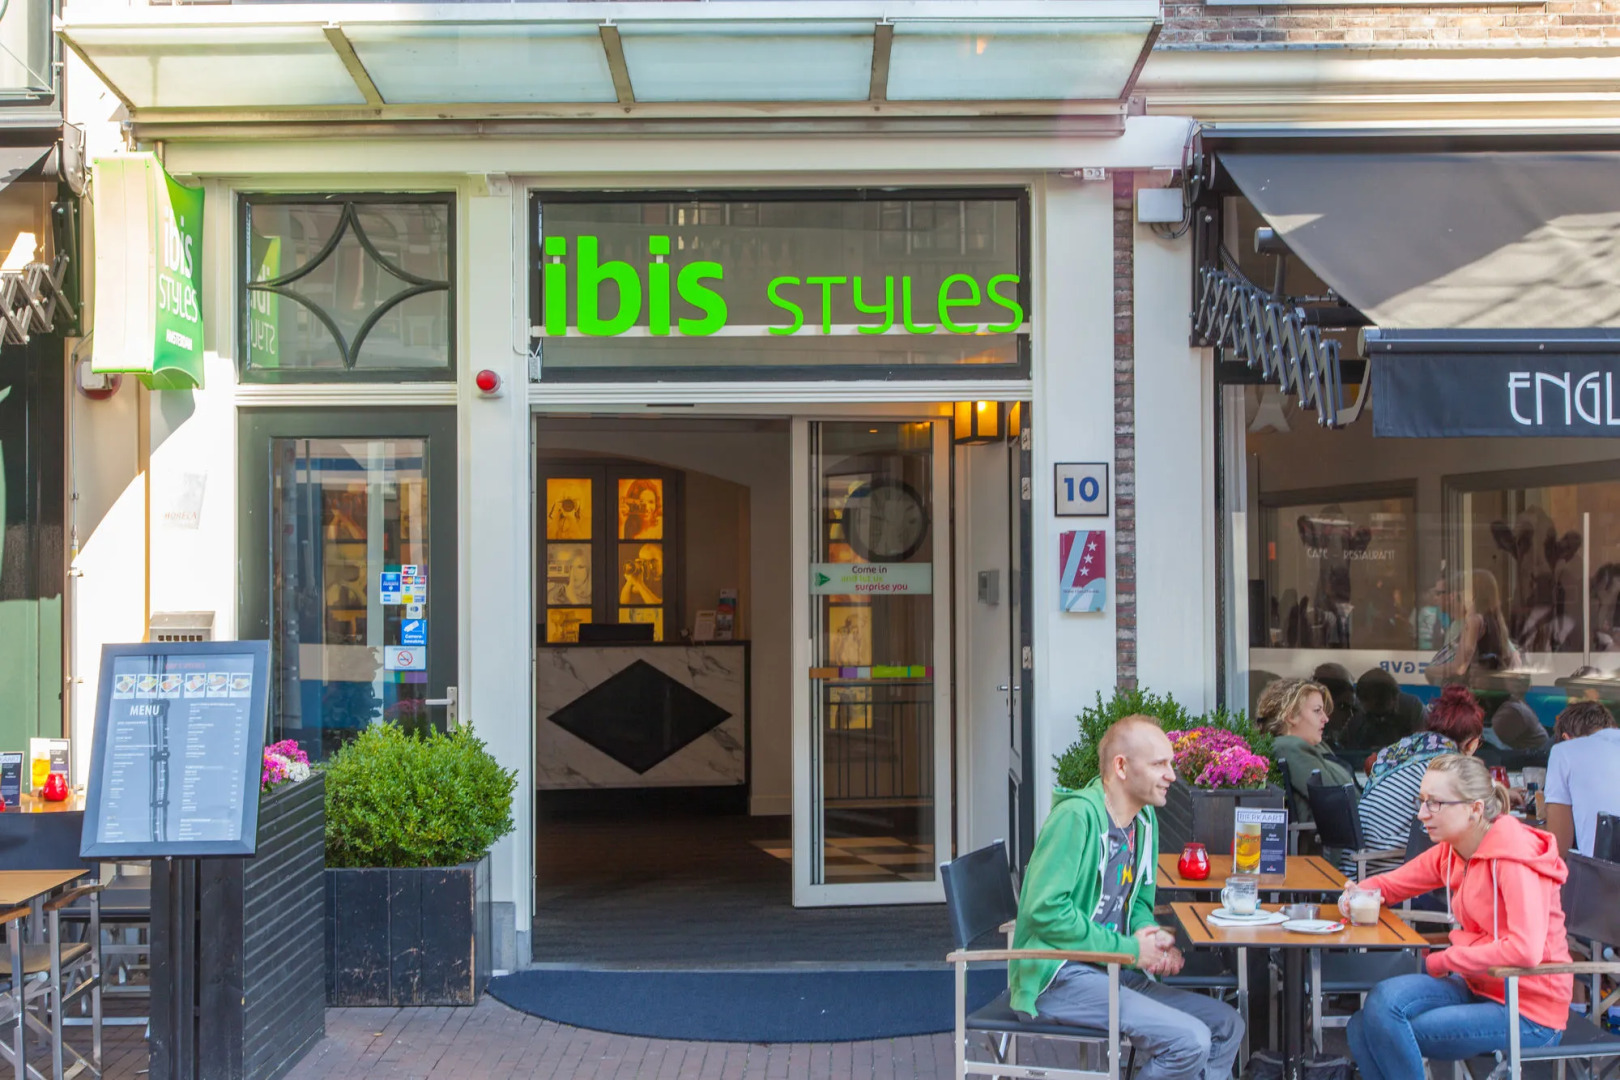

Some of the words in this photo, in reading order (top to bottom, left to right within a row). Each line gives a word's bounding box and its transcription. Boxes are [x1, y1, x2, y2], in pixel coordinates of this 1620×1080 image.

[163, 205, 193, 279] ibis
[545, 235, 728, 336] ibis
[1508, 371, 1620, 426] ENGL
[1064, 476, 1100, 502] 10
[852, 565, 877, 574] Come
[879, 565, 888, 574] in
[855, 583, 890, 592] surprise
[892, 583, 908, 592] you
[129, 704, 160, 716] MENU
